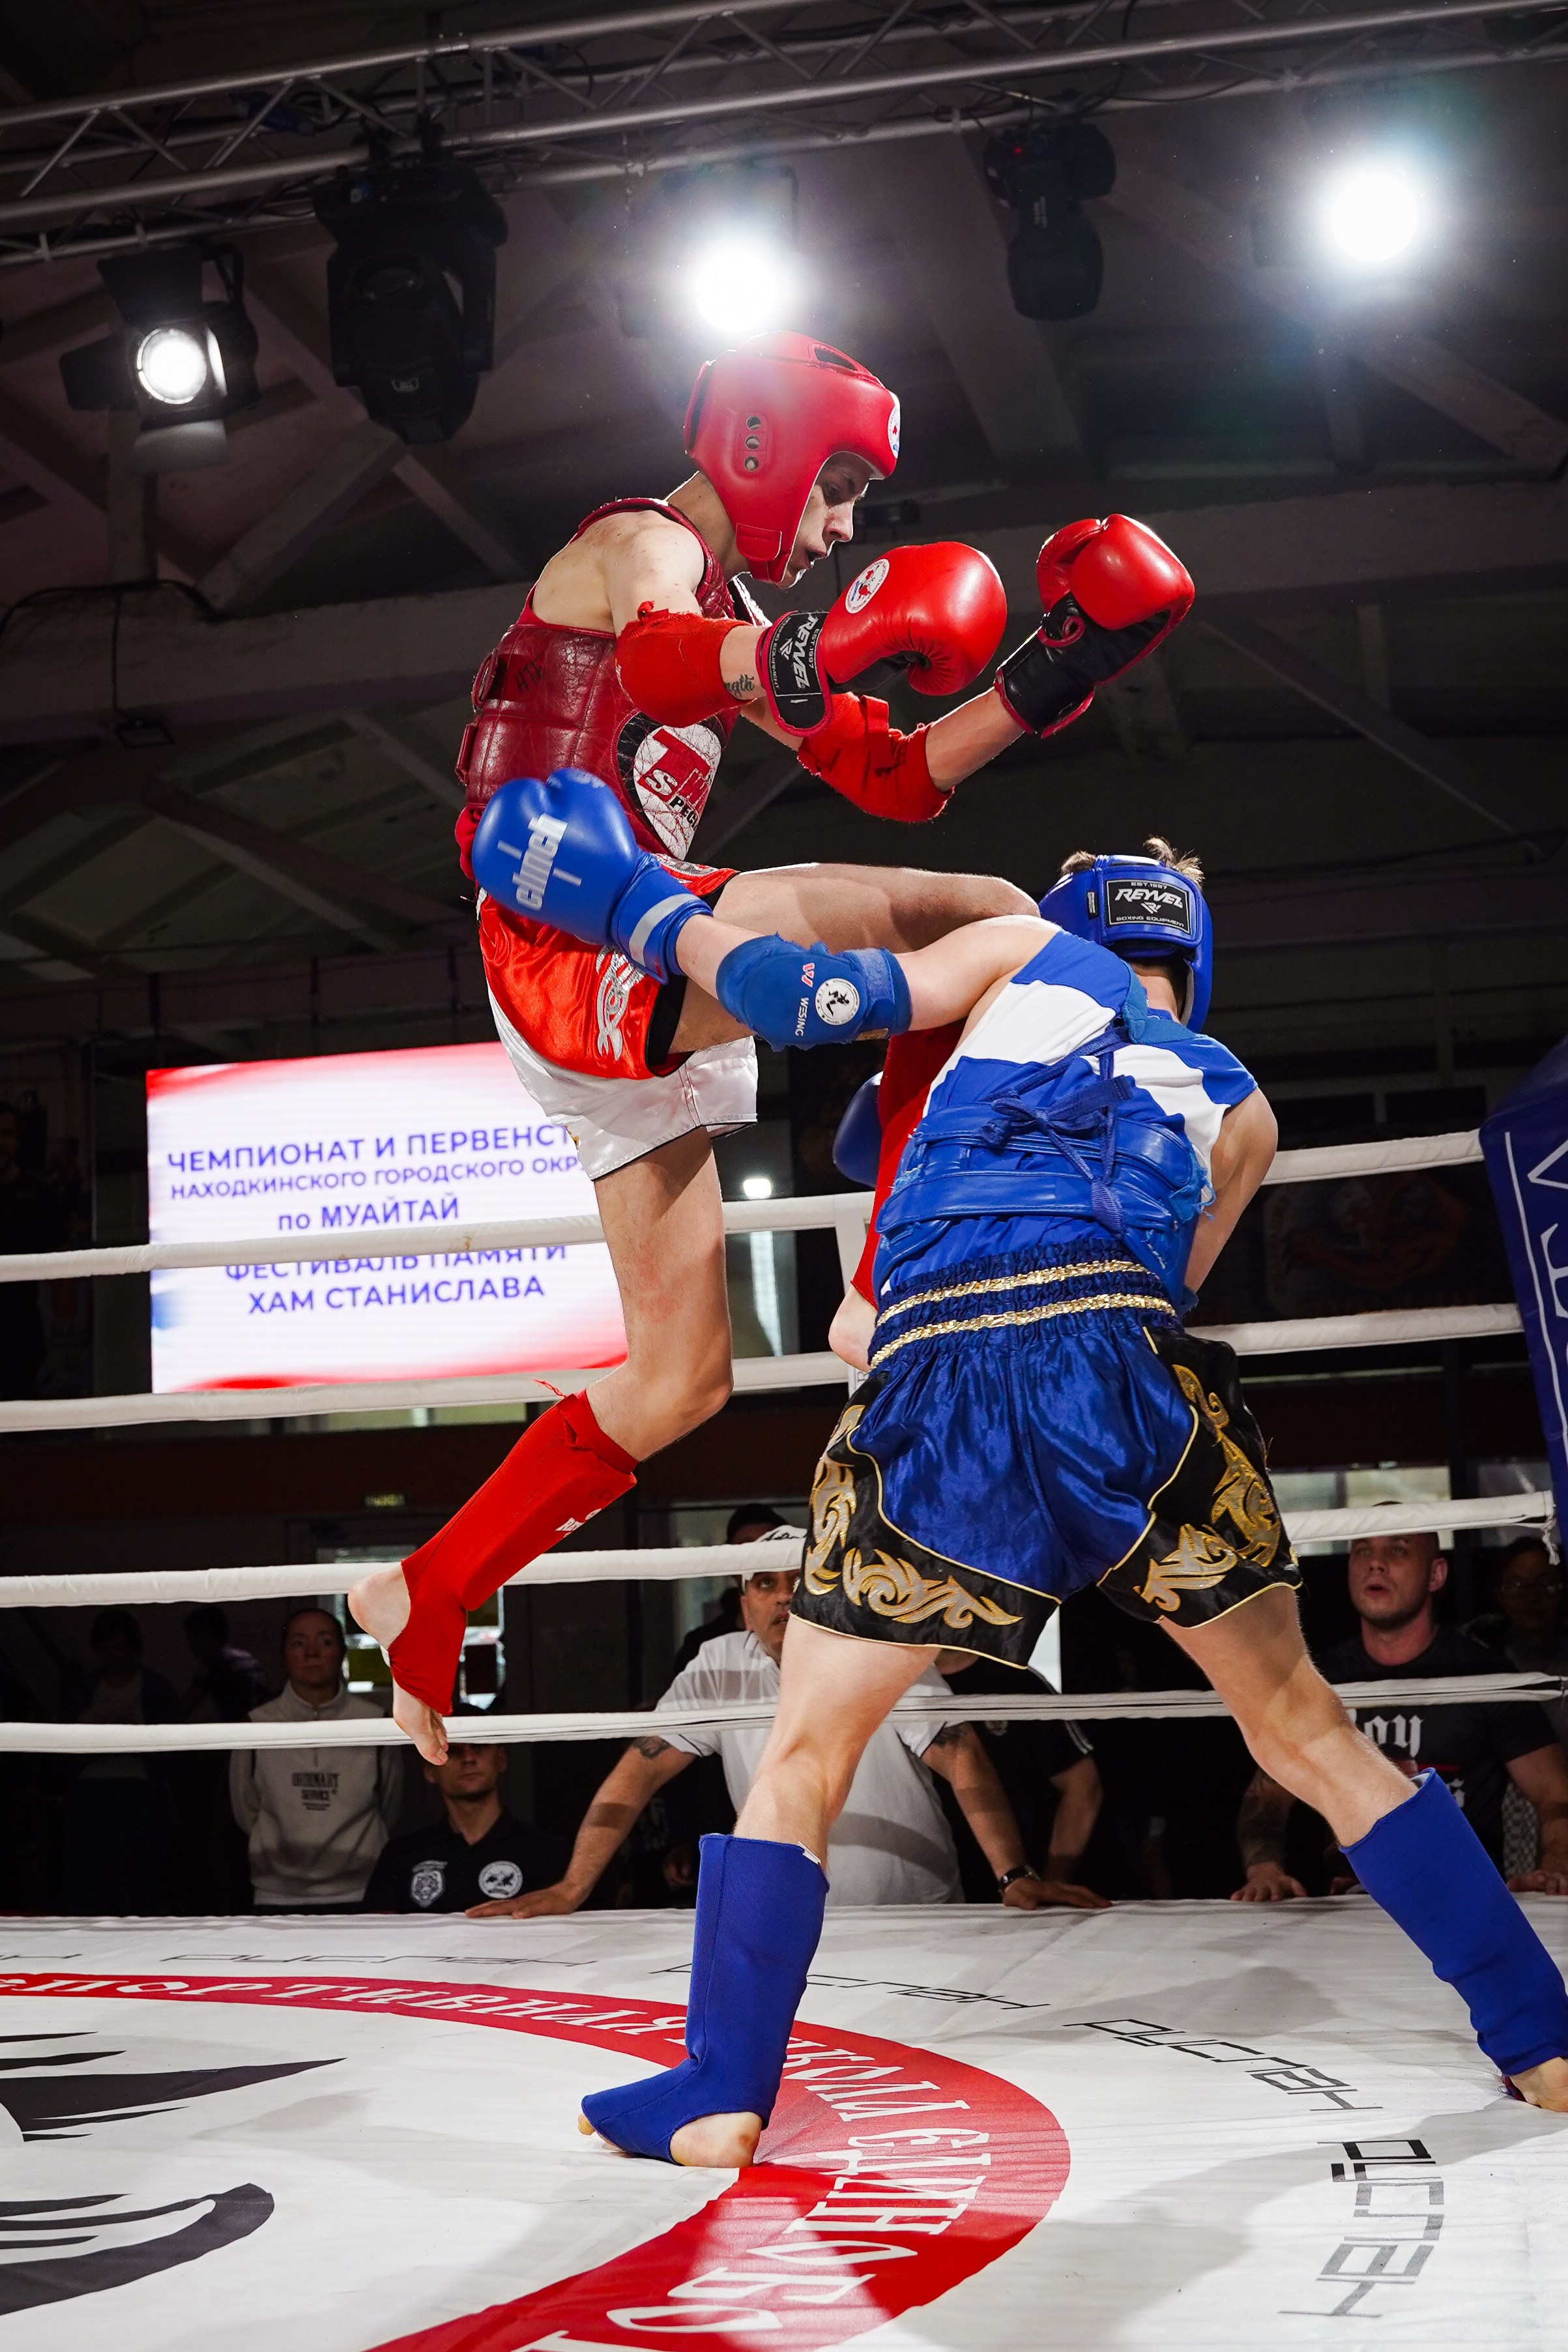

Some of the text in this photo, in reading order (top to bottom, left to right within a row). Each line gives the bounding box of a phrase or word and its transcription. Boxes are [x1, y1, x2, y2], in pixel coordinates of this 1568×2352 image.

[167, 1124, 568, 1173] ЧЕМПИОНАТ И ПЕРВЕНСТ
[171, 1155, 585, 1200] НАХОДКИНСКОГО ГОРОДСКОГО ОКР
[278, 1193, 459, 1231] по МУАЙТАЙ
[225, 1245, 566, 1281] ФЕСТИВАЛЬ ПАМЯТИ
[248, 1275, 545, 1315] ХАМ СТАНИСЛАВА
[783, 2037, 970, 2122] КОЛА
[536, 2127, 991, 2352] ЕДИНОБО
